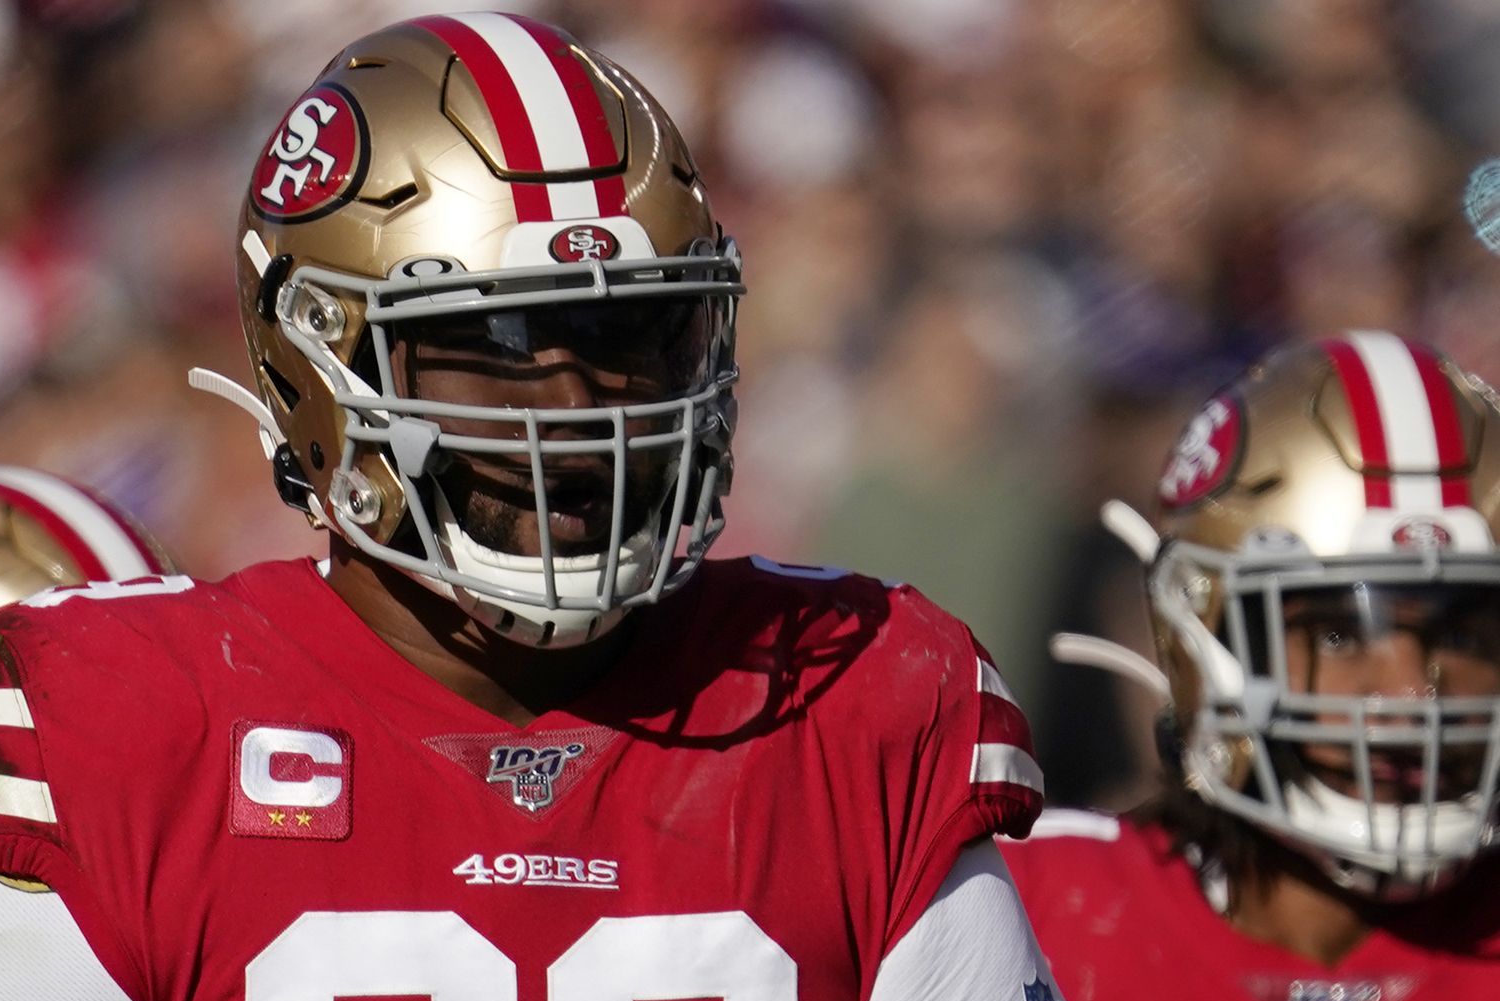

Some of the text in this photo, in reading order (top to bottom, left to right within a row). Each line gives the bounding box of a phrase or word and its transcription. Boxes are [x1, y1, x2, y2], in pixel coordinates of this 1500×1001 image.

[261, 96, 337, 206] SF
[568, 229, 607, 262] SF
[241, 727, 343, 807] C
[452, 853, 619, 890] 49ERS
